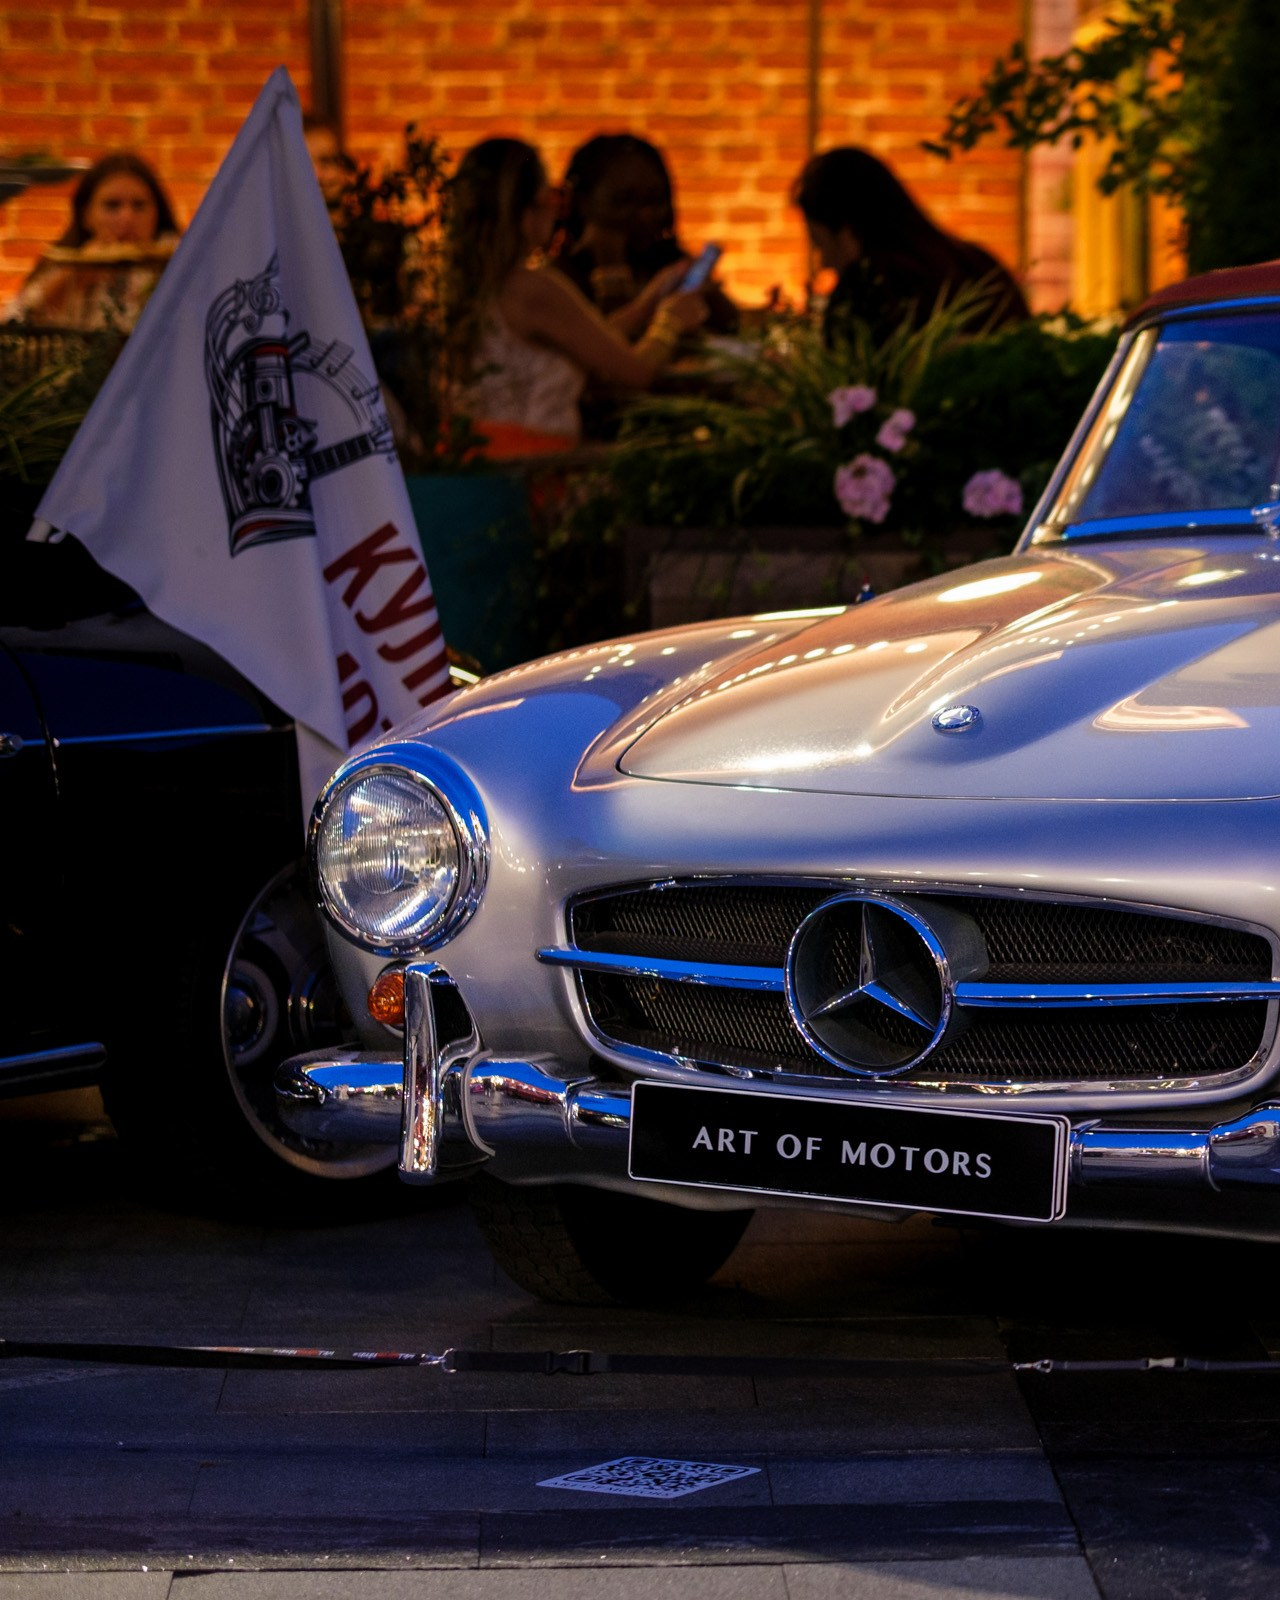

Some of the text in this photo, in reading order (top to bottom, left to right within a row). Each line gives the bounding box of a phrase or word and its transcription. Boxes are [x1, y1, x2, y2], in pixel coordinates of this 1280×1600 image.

[692, 1126, 993, 1179] ART OF MOTORS
